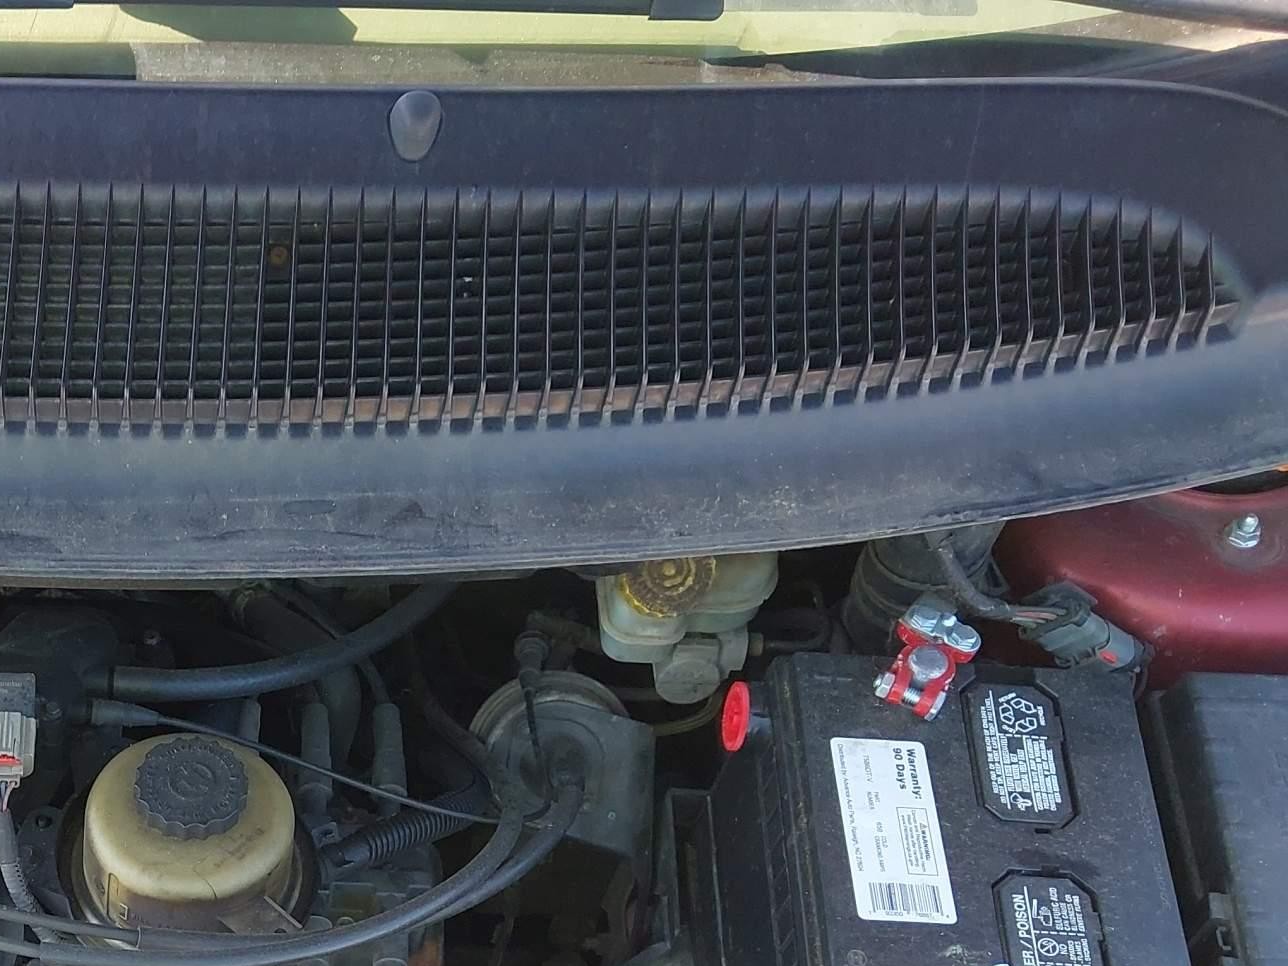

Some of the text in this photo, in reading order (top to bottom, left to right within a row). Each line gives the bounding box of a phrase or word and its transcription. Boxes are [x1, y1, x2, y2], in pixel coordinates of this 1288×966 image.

[893, 747, 907, 789] 90 Days
[905, 748, 922, 799] Warranty:
[1012, 894, 1031, 938] POISON
[1059, 944, 1068, 954] NO
